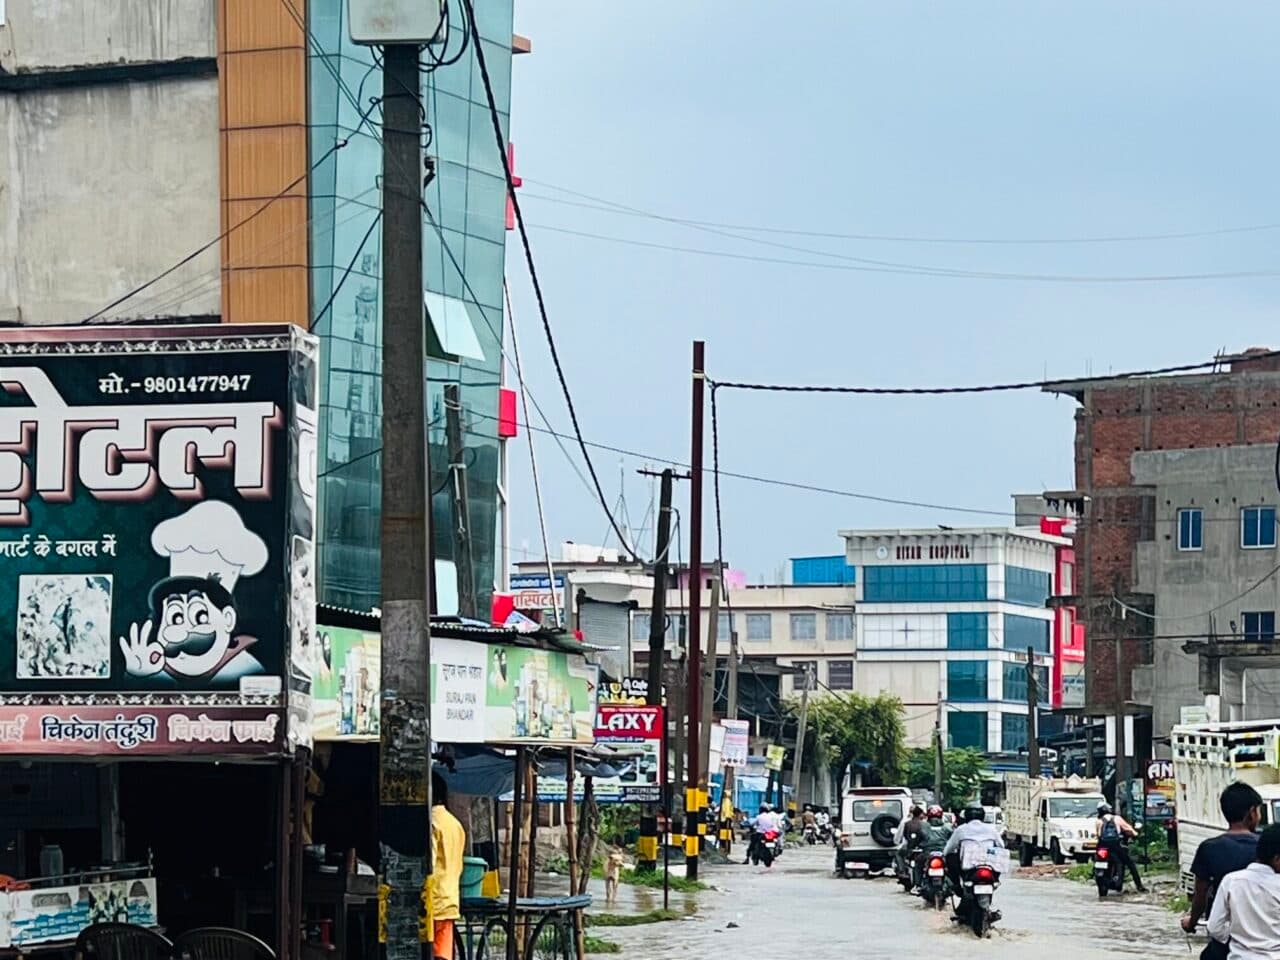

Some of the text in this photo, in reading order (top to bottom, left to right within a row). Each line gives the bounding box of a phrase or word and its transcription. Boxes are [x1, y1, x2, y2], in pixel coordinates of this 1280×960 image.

[33, 535, 52, 557] के
[55, 540, 98, 557] बगल
[102, 534, 117, 557] में
[929, 545, 970, 559] HOSPITAL
[41, 715, 101, 742] चिकेन
